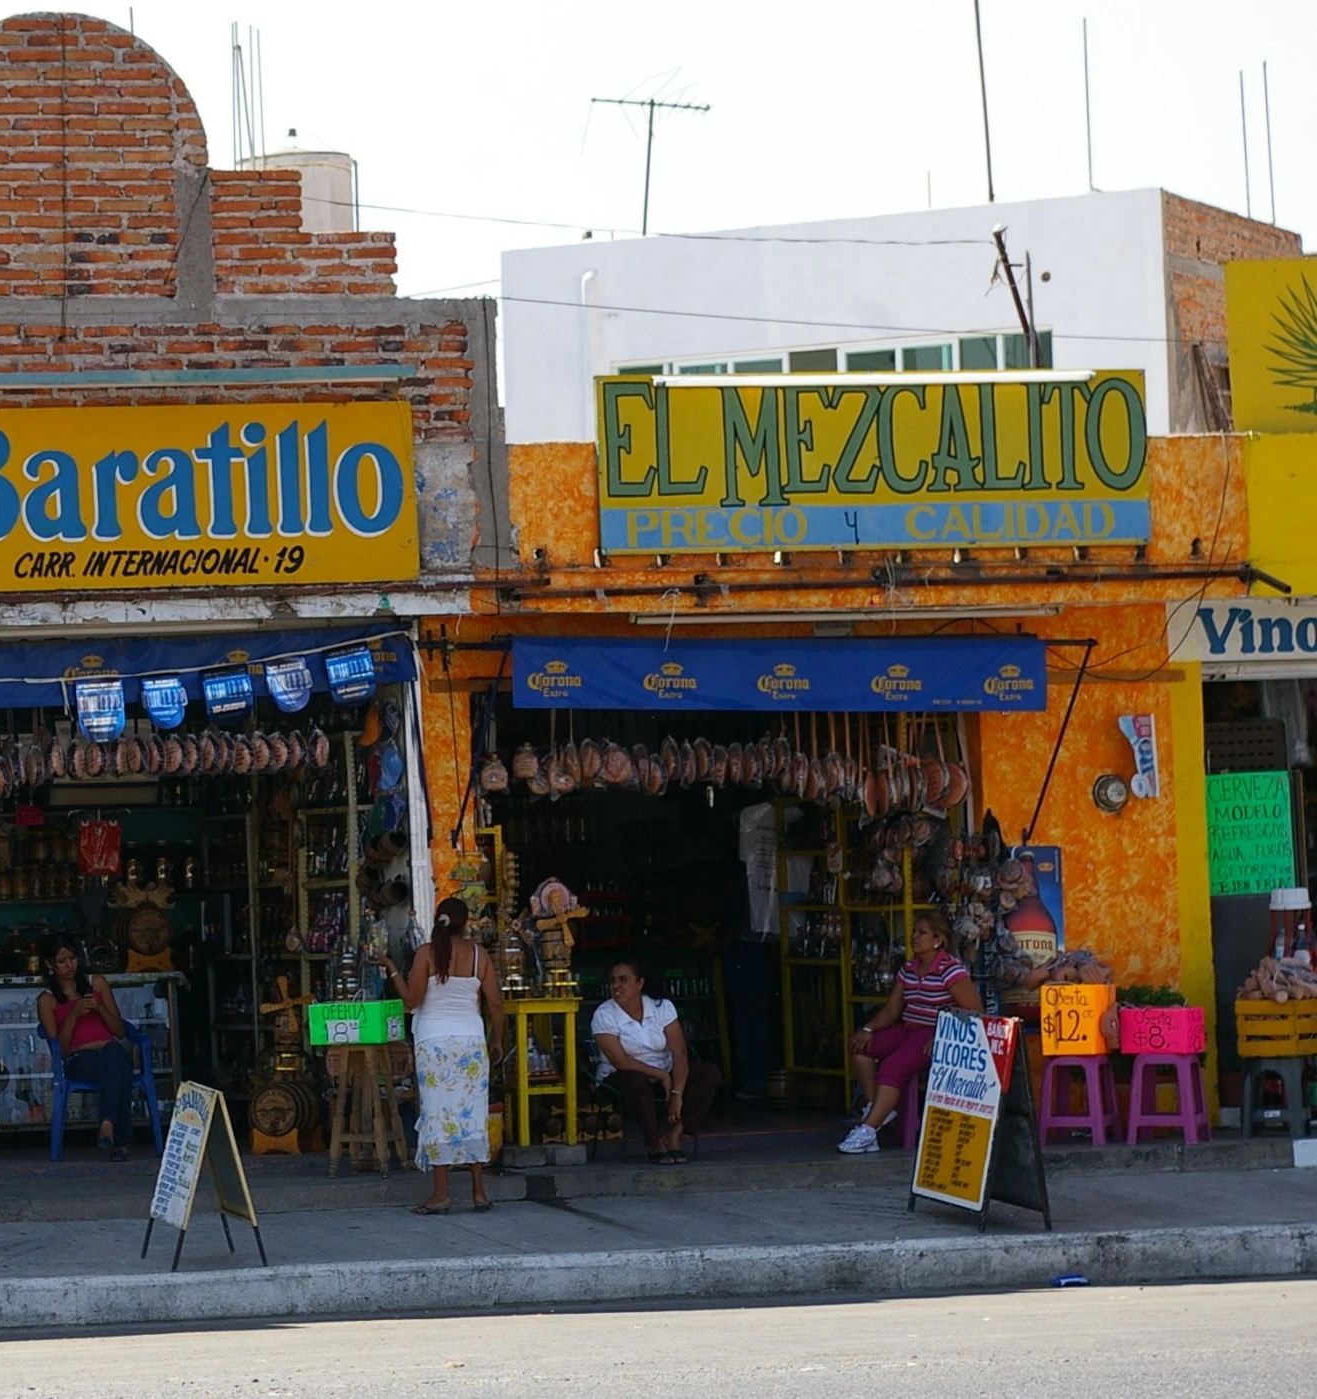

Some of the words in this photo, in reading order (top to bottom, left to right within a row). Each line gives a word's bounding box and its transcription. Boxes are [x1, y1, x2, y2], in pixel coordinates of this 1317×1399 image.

[603, 381, 709, 497] EL
[718, 377, 1148, 507] MEZCALITO
[626, 510, 808, 548] PRECIO
[904, 501, 1116, 541] CALIDAD
[14, 551, 76, 579] CARR.
[81, 548, 261, 578] INTERNACIONAL
[527, 672, 583, 692] Corona
[642, 673, 698, 692] Corona
[757, 674, 811, 693] Corona
[870, 675, 923, 695] Corona
[983, 675, 1034, 695] Corona
[1207, 775, 1288, 803] CERVEZA
[1017, 938, 1054, 951] orona
[933, 1040, 988, 1072] LICORES
